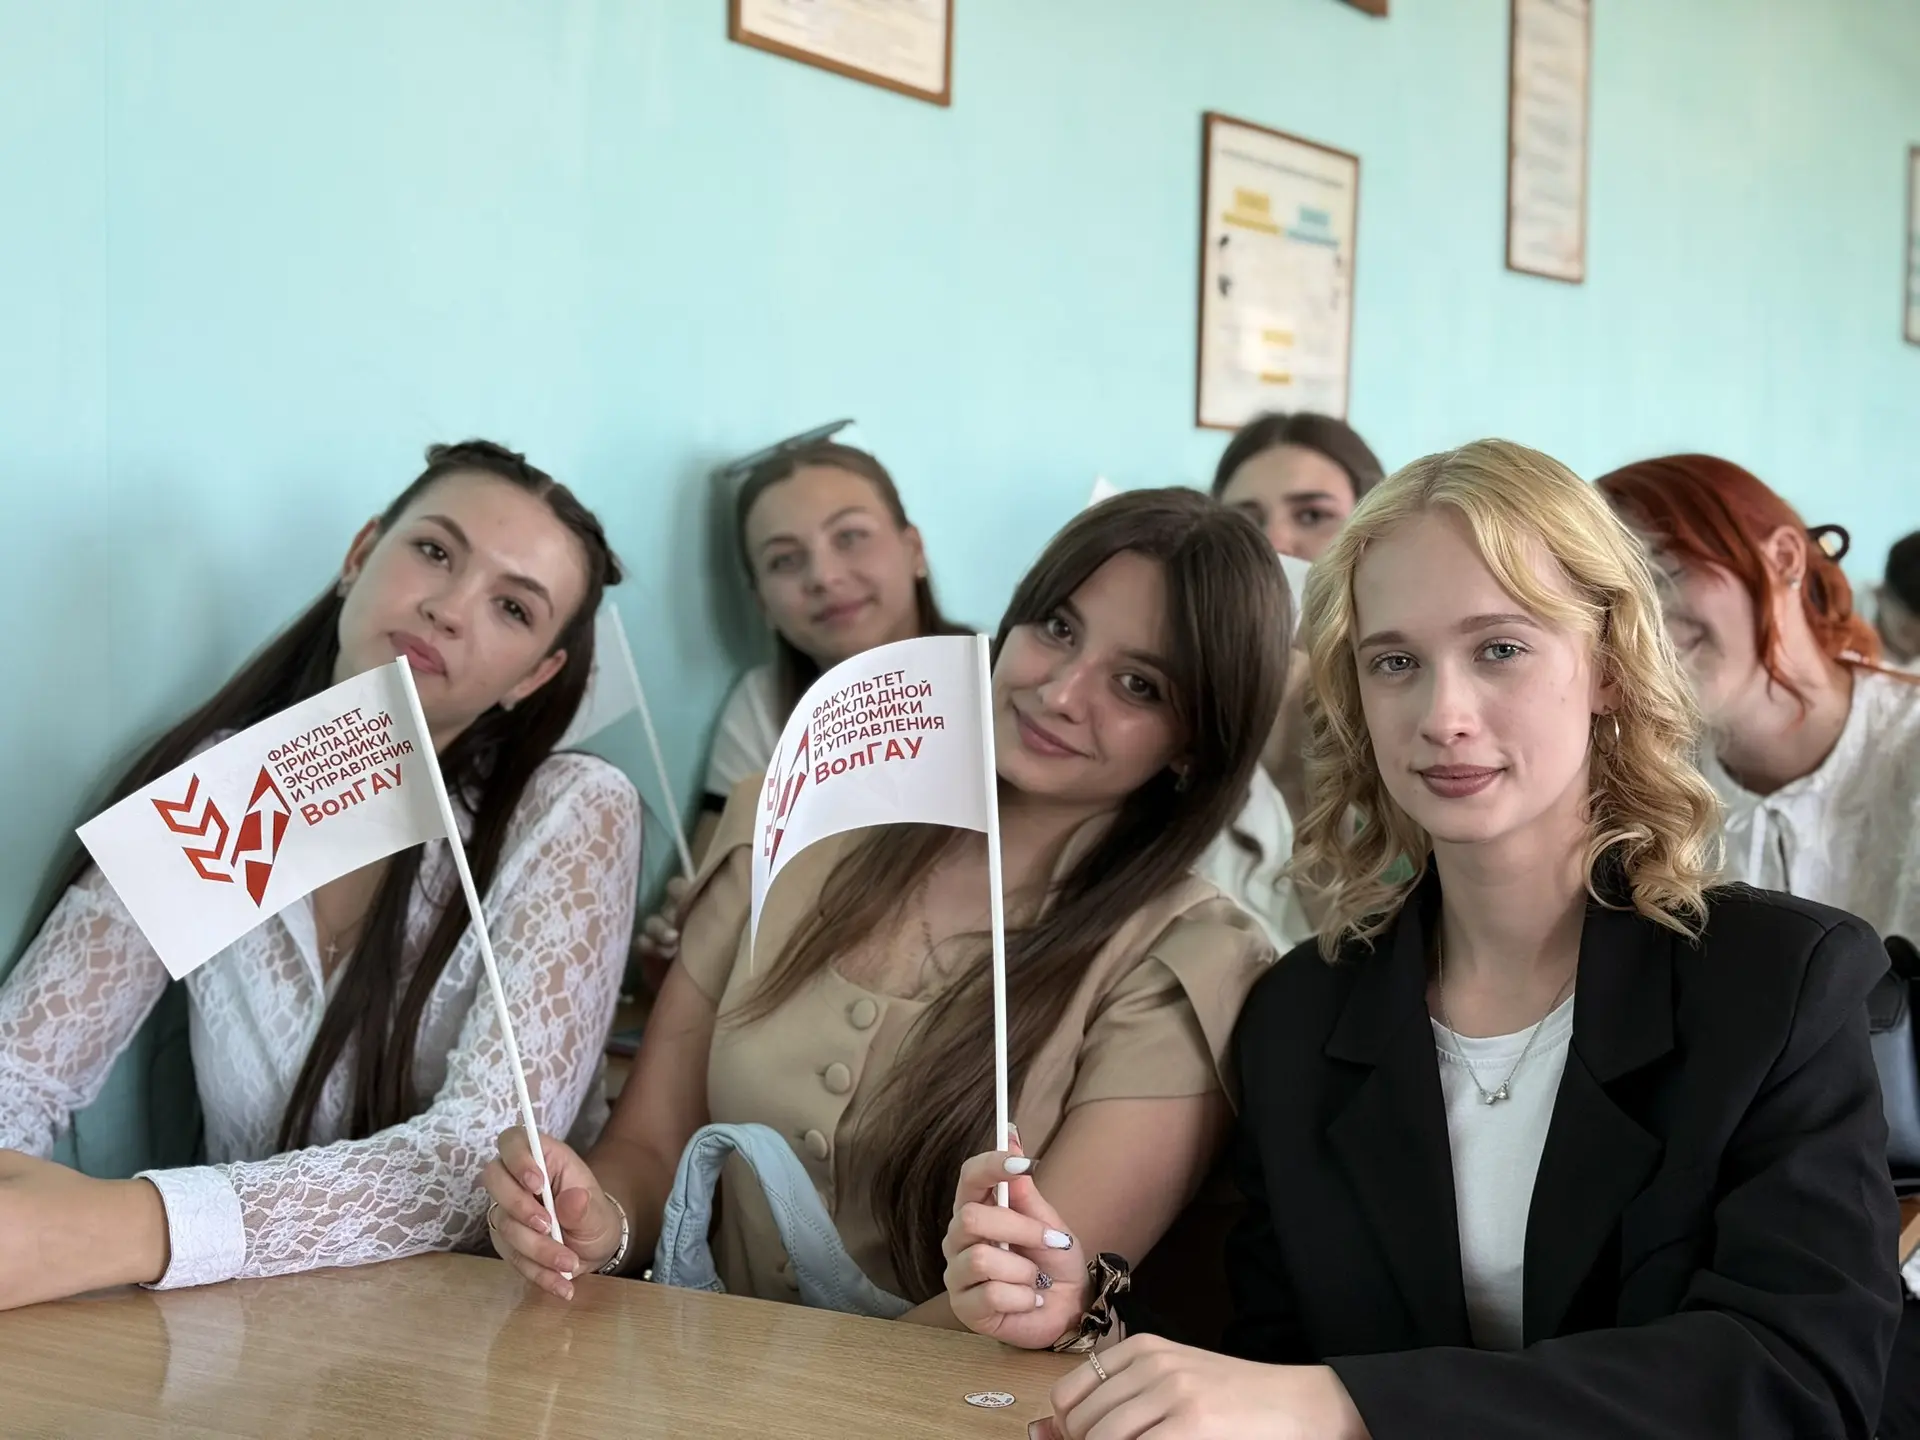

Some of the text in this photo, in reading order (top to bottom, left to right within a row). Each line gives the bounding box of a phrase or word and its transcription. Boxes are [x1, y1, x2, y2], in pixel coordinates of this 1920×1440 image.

[812, 670, 905, 719] ФАКУЛЬТЕТ
[812, 680, 932, 734] ПРИКЛАДНОЙ
[267, 707, 363, 763] ФАКУЛЬТЕТ
[273, 711, 393, 777] ПРИКЛАДНОЙ
[813, 700, 923, 747] ЭКОНОМИКИ
[814, 716, 945, 761] И УПРАВЛЕНИЯ
[283, 730, 392, 790] ЭКОНОМИКИ
[291, 739, 414, 803] И УПРАВЛЕНИЯ
[815, 736, 923, 785] ВолГАУ
[299, 763, 404, 827] ВолГАУ
